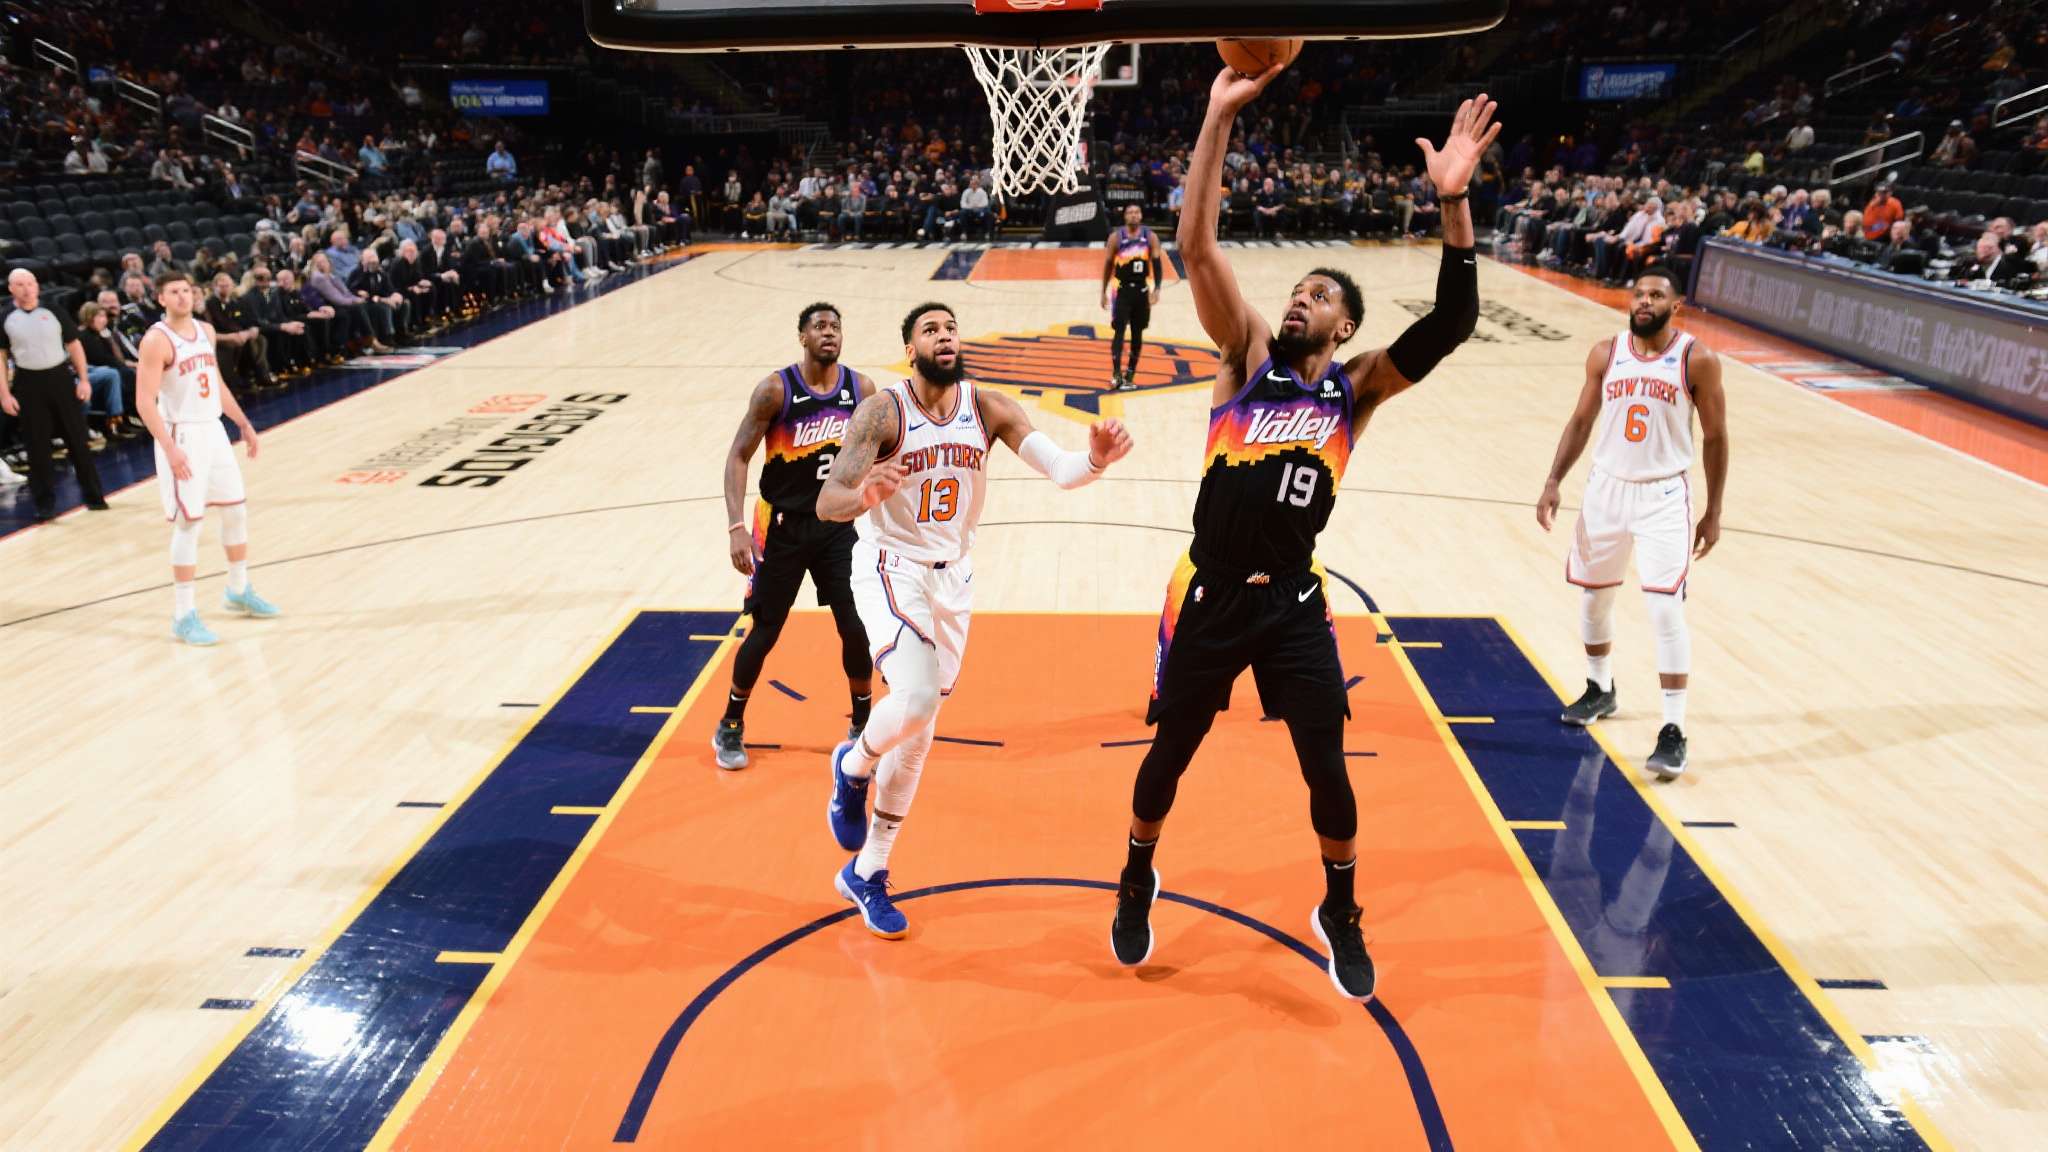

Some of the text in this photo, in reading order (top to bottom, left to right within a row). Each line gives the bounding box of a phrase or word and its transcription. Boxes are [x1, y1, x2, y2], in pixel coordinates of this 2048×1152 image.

[197, 373, 210, 398] 3
[1243, 406, 1341, 450] Valley
[1624, 404, 1650, 442] 6
[916, 477, 960, 523] 13
[1276, 462, 1319, 507] 19
